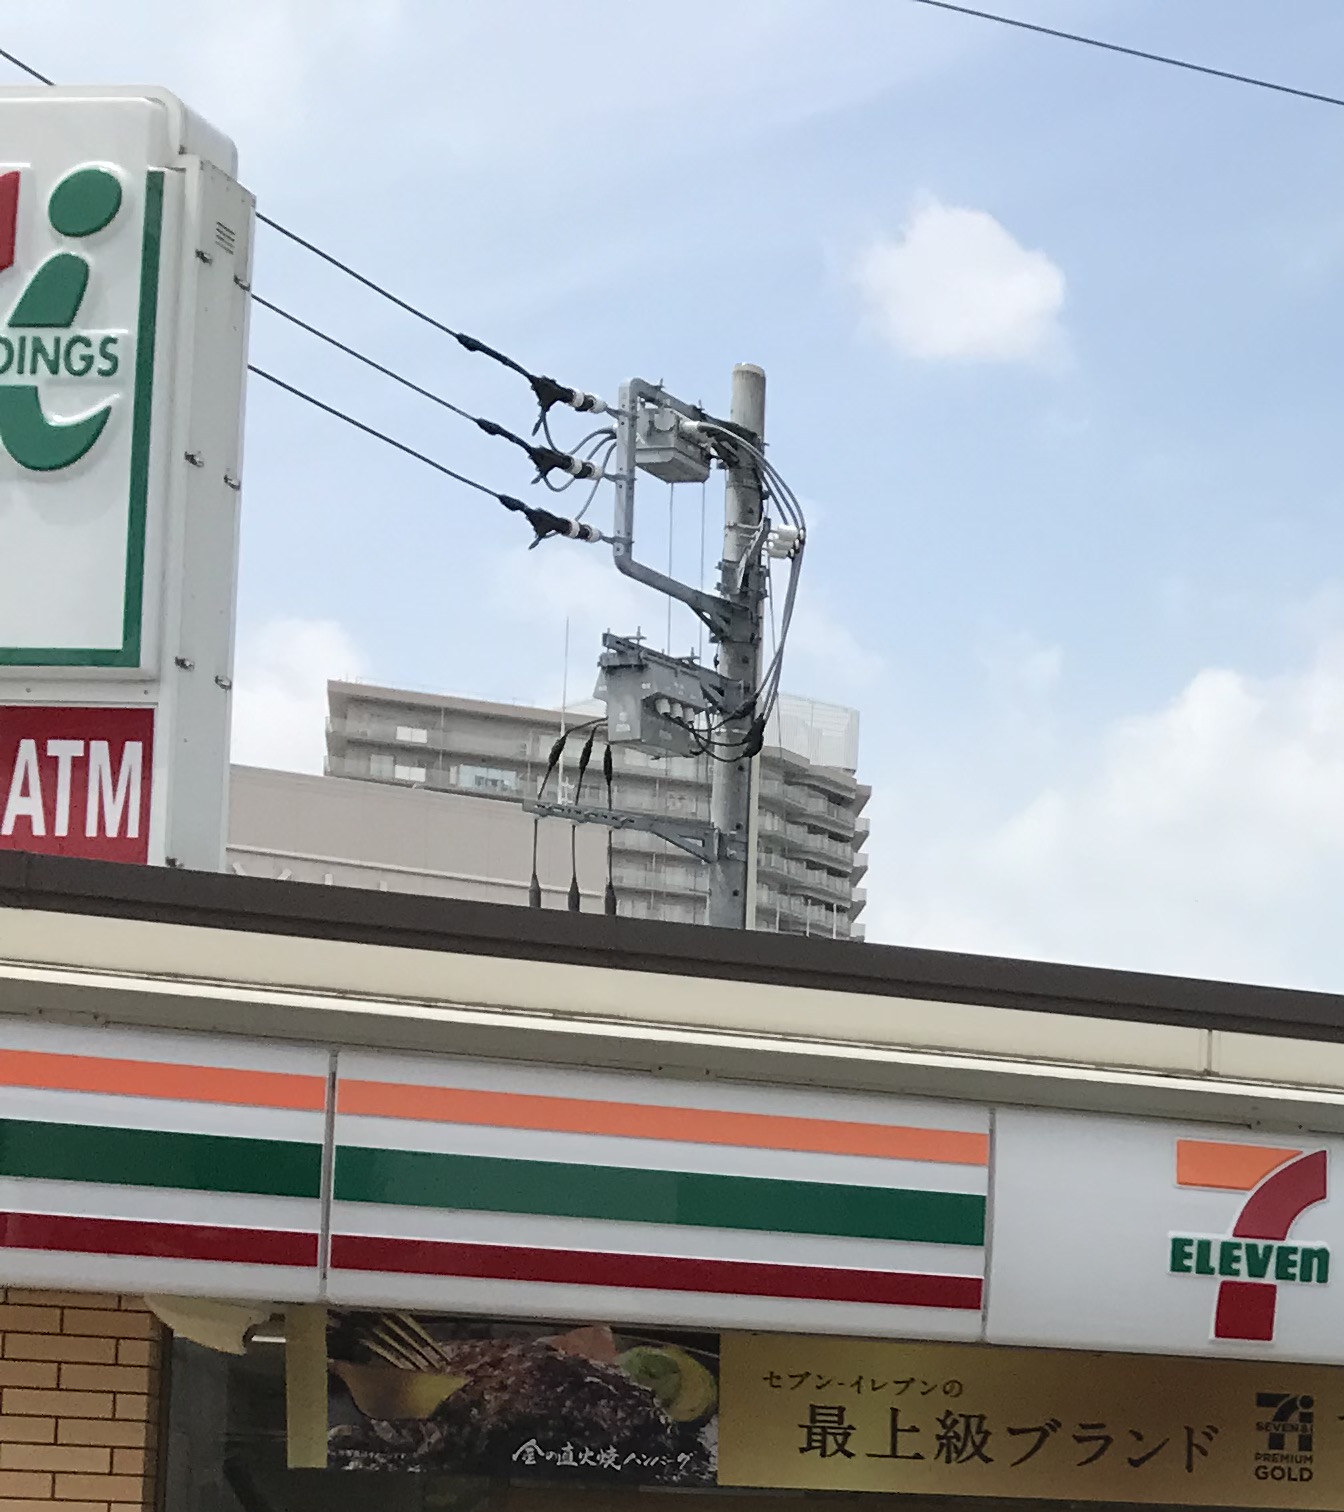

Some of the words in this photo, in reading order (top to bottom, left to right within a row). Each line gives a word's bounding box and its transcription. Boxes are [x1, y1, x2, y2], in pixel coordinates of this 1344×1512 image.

[1, 738, 143, 838] ATM
[798, 1404, 1219, 1473] 最上級ブランド
[1254, 1452, 1314, 1465] PREMIUM
[1255, 1465, 1314, 1482] GOLD
